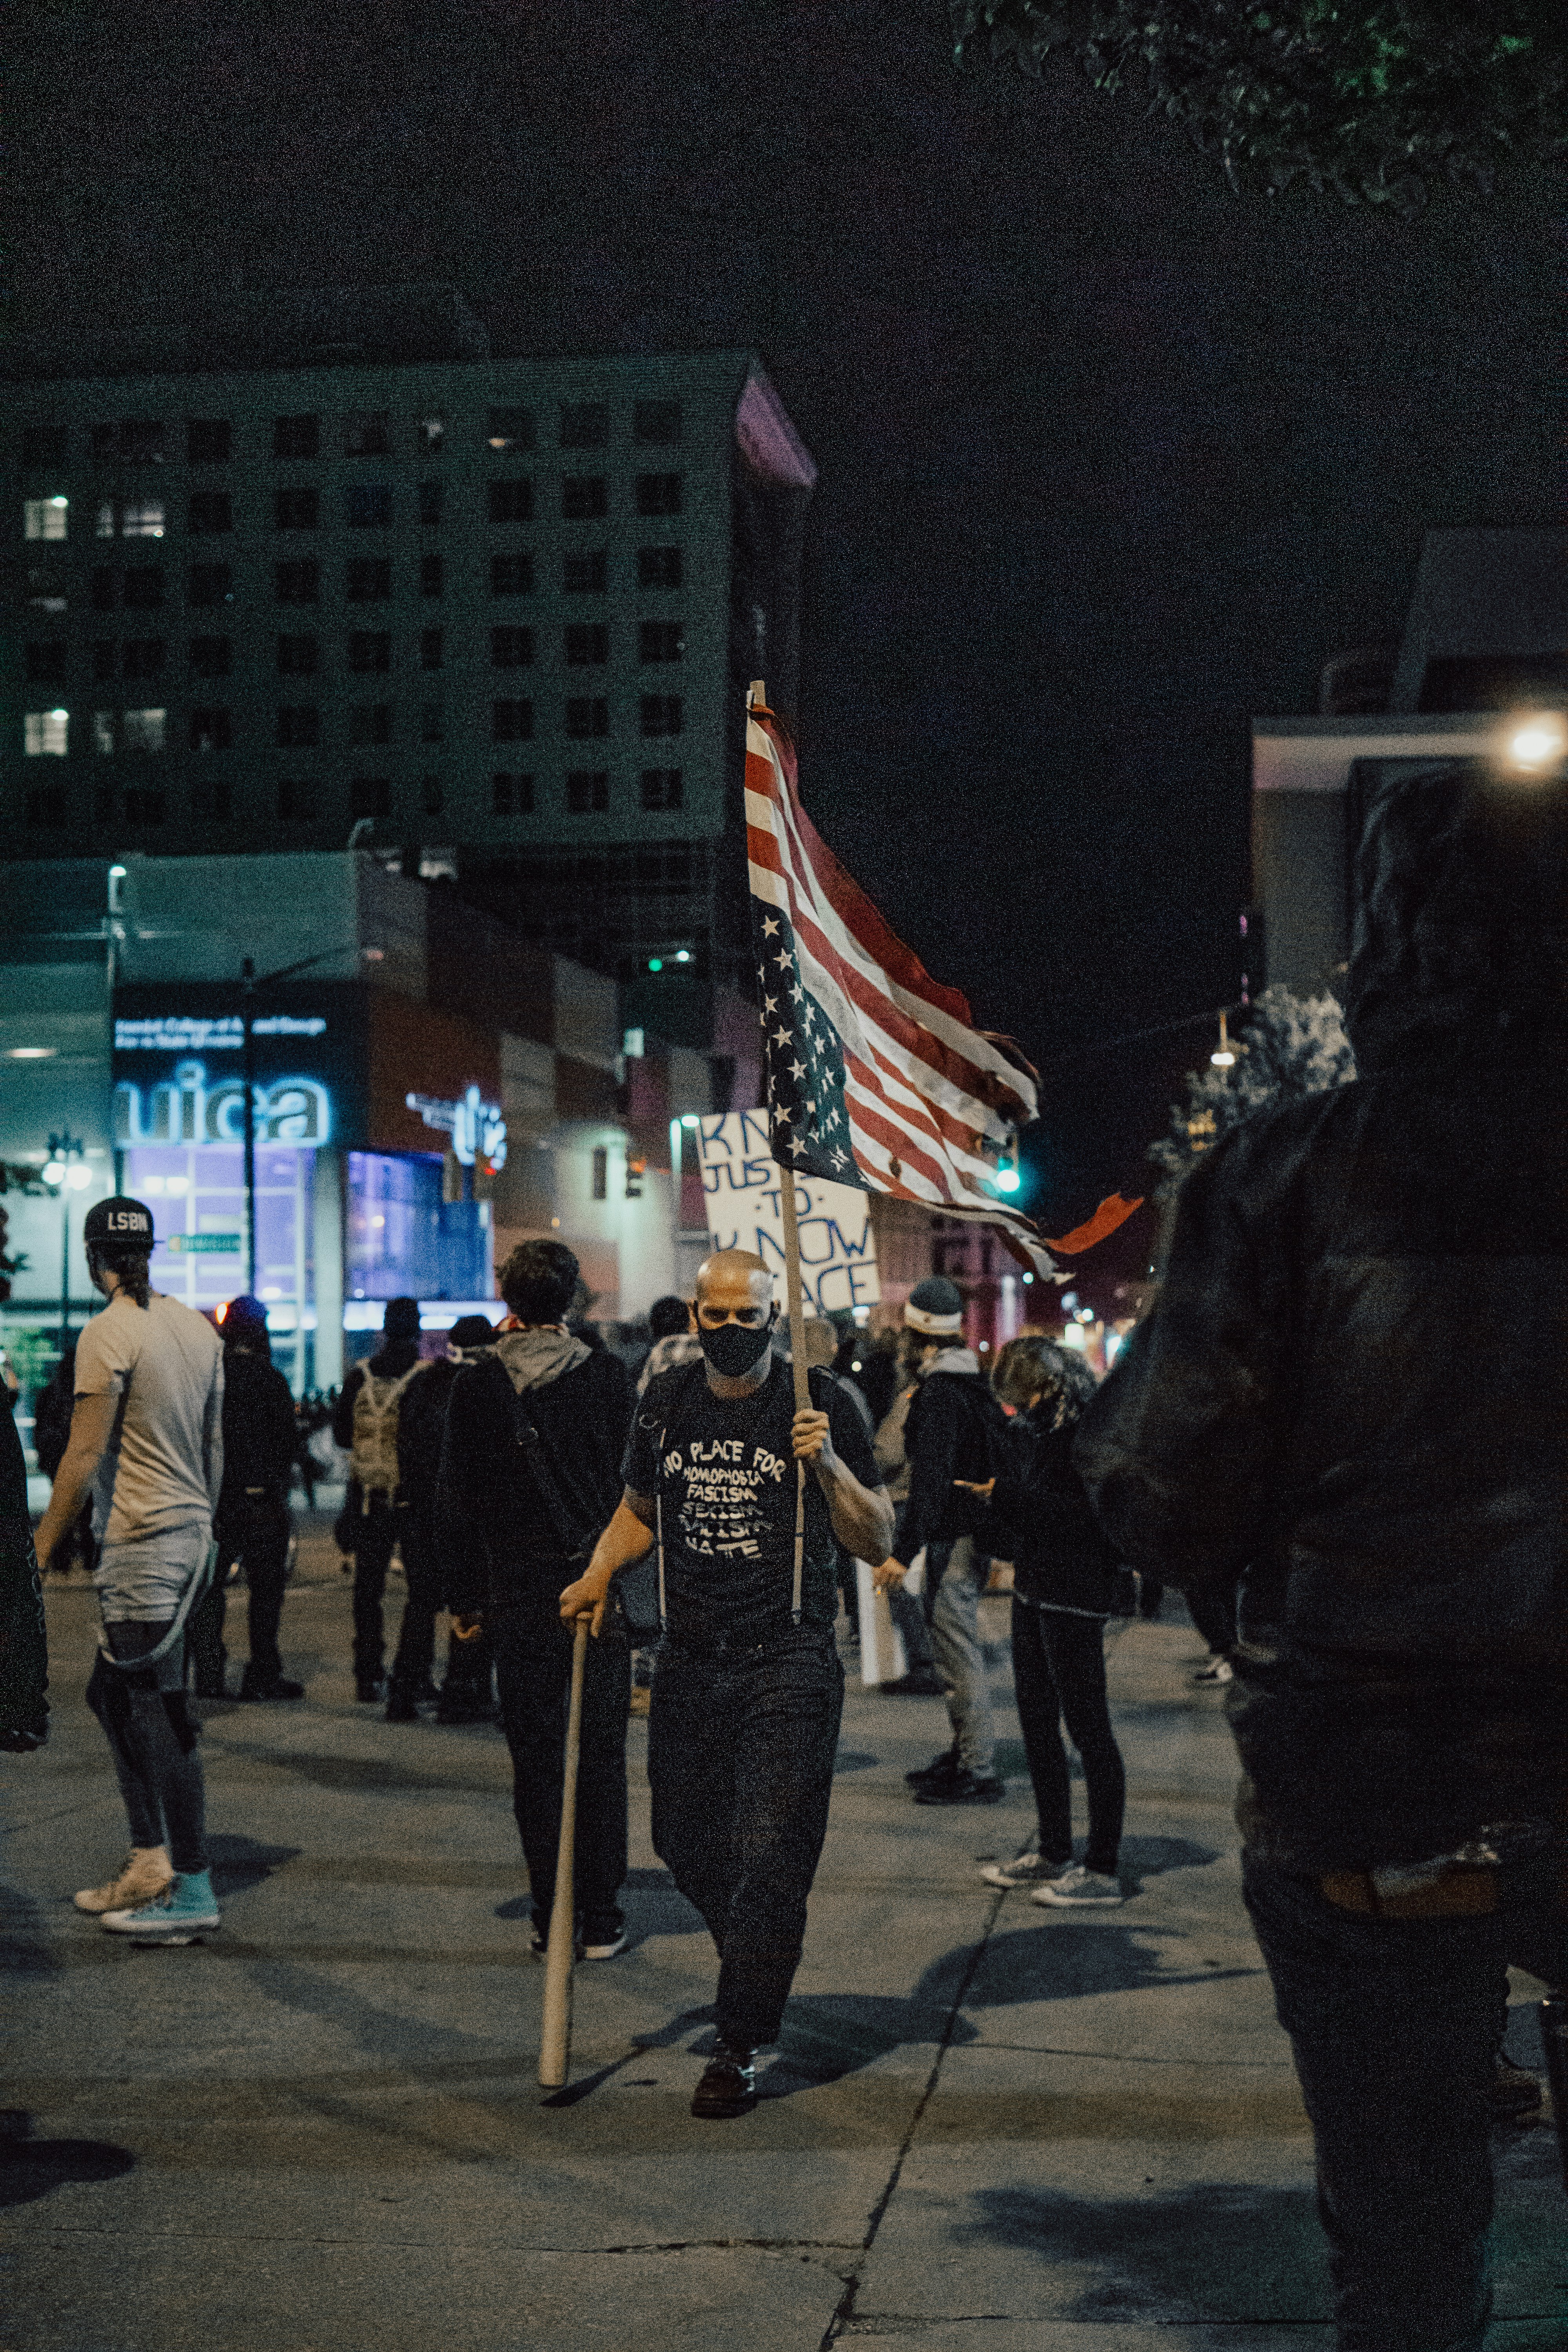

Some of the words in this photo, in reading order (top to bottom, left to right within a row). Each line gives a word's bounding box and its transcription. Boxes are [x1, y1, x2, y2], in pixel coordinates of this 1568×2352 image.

[664, 1450, 683, 1478] NO
[690, 1440, 745, 1462] PLACE
[753, 1447, 787, 1483] FOR
[683, 1467, 765, 1486] HOMOPHOBIA
[688, 1484, 758, 1503] FASCISM
